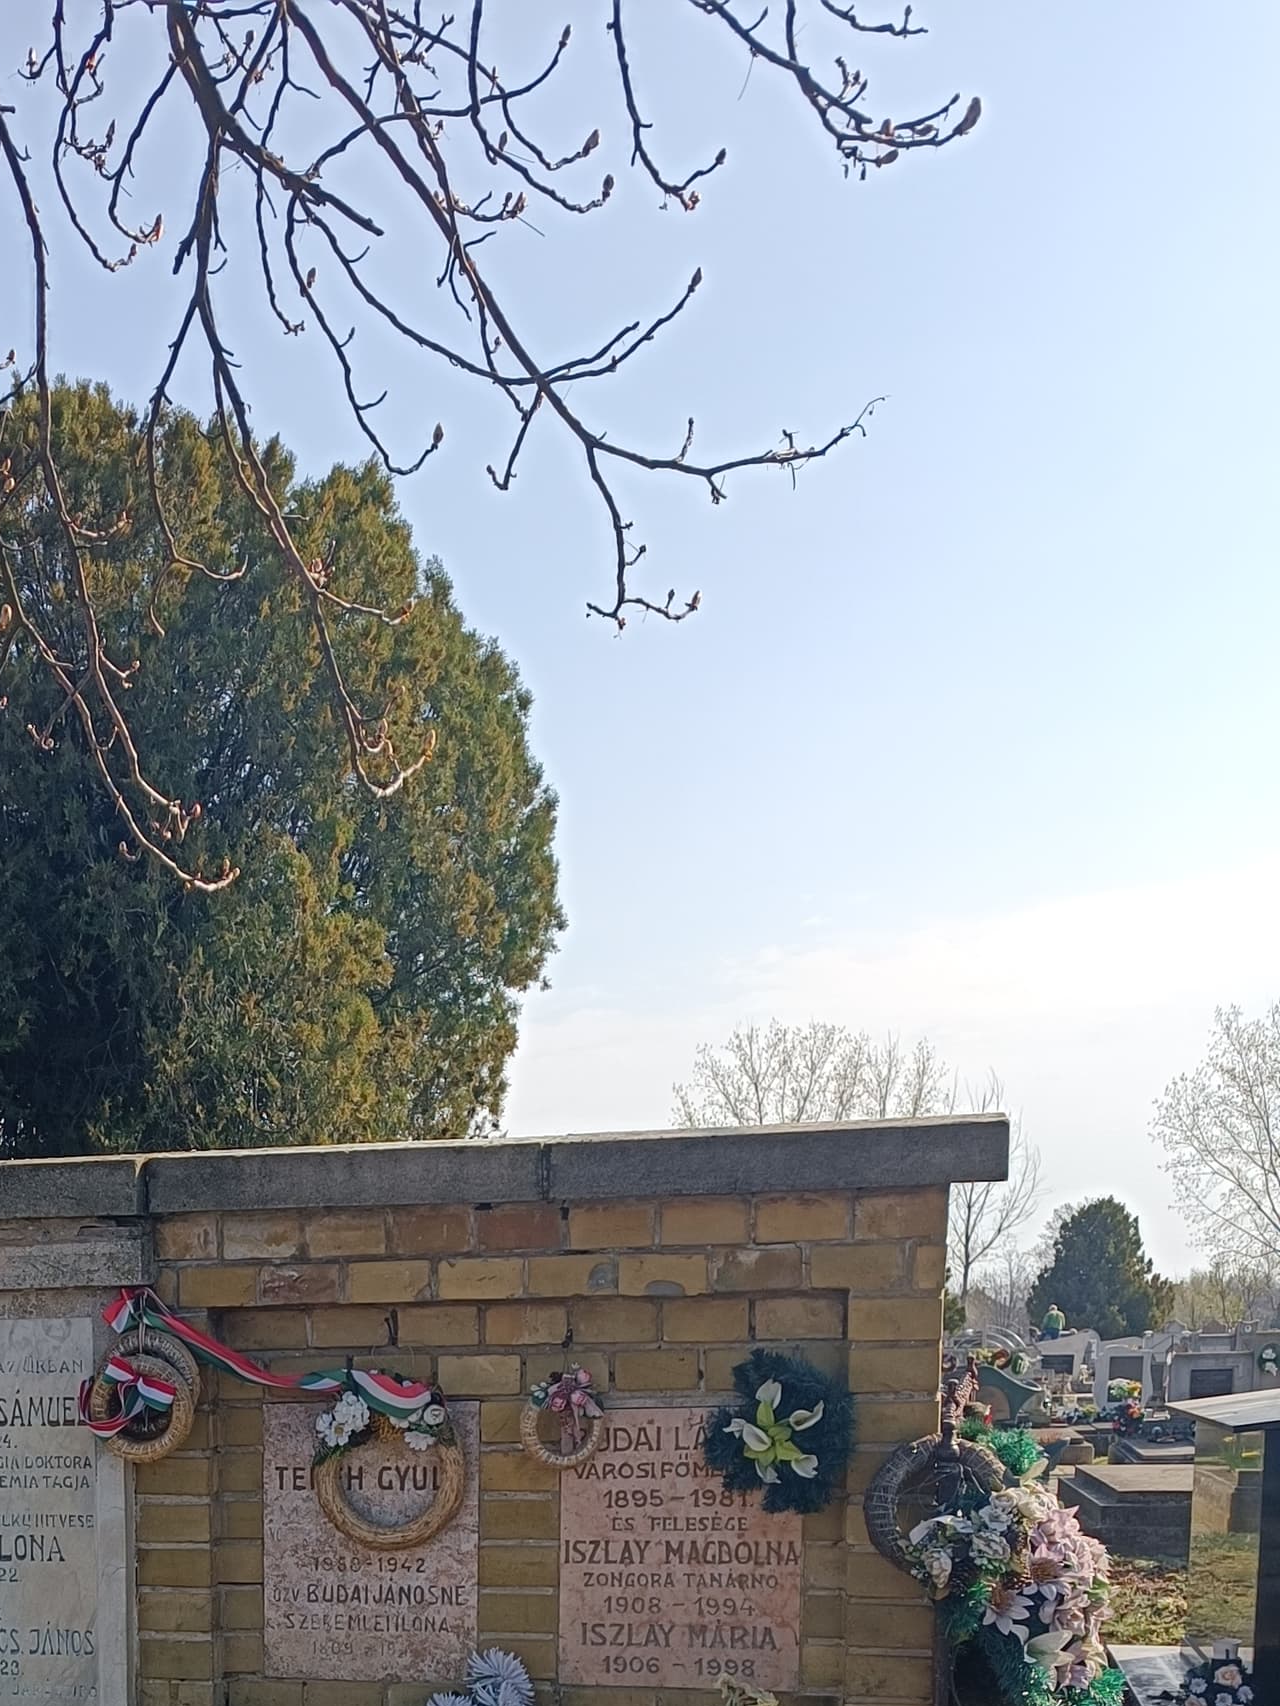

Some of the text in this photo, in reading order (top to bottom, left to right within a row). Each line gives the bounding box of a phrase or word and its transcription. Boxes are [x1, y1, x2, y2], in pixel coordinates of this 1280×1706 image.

[597, 1425, 662, 1453] UDAI
[23, 1455, 93, 1470] DOKTORA
[377, 1464, 442, 1492] GYUL
[603, 1489, 665, 1510] 1895
[563, 1539, 801, 1567] ISZLAY MAGDOLNA
[583, 1571, 676, 1589] ZONGORA
[306, 1582, 369, 1606] BUDAI
[603, 1595, 662, 1615] 1908
[580, 1622, 676, 1648] ISZLAY
[601, 1655, 661, 1676] 1906
